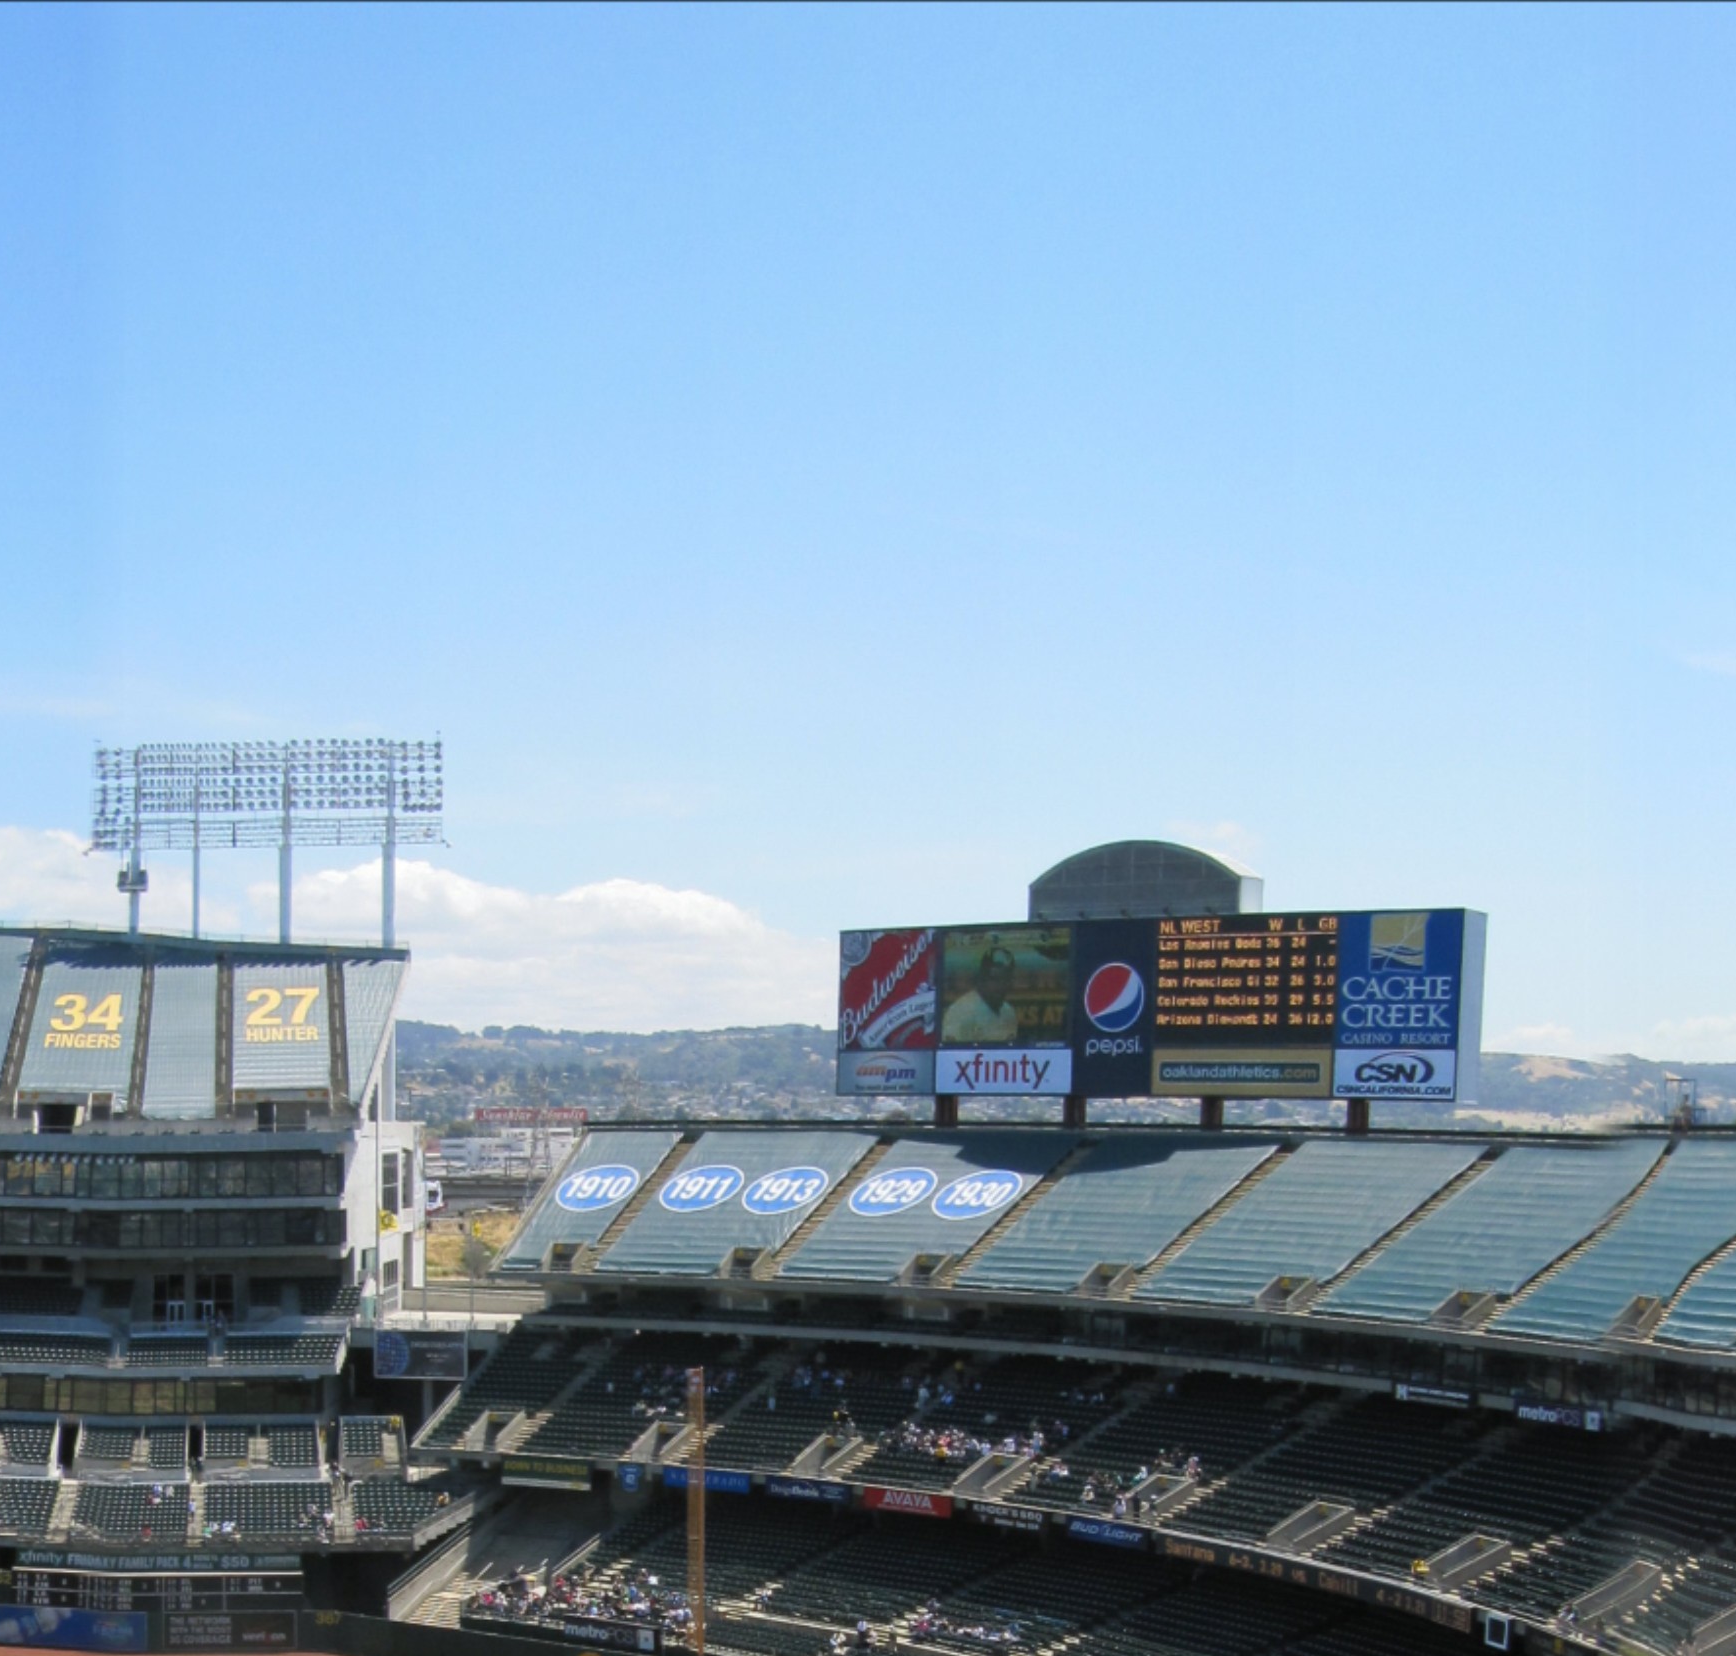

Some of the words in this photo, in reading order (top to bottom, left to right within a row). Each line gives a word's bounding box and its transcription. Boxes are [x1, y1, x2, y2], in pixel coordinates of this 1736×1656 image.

[1160, 920, 1176, 934] NL
[1181, 919, 1221, 933] WEST
[1268, 918, 1283, 931] W
[1297, 918, 1306, 931] L
[1319, 917, 1338, 930] GB
[1315, 955, 1337, 967] 1.0
[841, 928, 934, 1046] Budweiser
[1314, 974, 1335, 986] 3.0
[1342, 976, 1452, 1001] CACHE
[49, 993, 124, 1032] 34
[245, 986, 320, 1026] 27
[1342, 1003, 1451, 1029] CREEK
[1156, 1013, 1202, 1025] Arizona
[43, 1032, 122, 1050] FINGERS
[245, 1024, 319, 1042] HUNTER
[1342, 1032, 1393, 1045] CASINO
[1400, 1032, 1451, 1045] RESORT
[1086, 1036, 1140, 1057] pepsi
[856, 1065, 916, 1083] ampm
[954, 1053, 1050, 1090] xfinity
[1162, 1064, 1317, 1079] oaklandathletics.com
[1354, 1062, 1417, 1084] CSN
[565, 1175, 638, 1198] 1910
[668, 1175, 732, 1201] 1911
[752, 1179, 821, 1203] 1913
[858, 1178, 926, 1203] 1929
[941, 1181, 1013, 1208] 1930
[1518, 1405, 1581, 1427] metroPCS
[883, 1490, 933, 1510] AVAYA
[1070, 1520, 1100, 1535] BUD
[1105, 1527, 1143, 1542] LIGHT
[19, 1551, 63, 1566] xfinity
[118, 1554, 155, 1569] FAMILY
[155, 1556, 179, 1569] PACK
[221, 1555, 250, 1569] $50
[1166, 1538, 1215, 1562] Santana
[1319, 1568, 1358, 1596] Cahill
[564, 1623, 634, 1644] metroPCS
